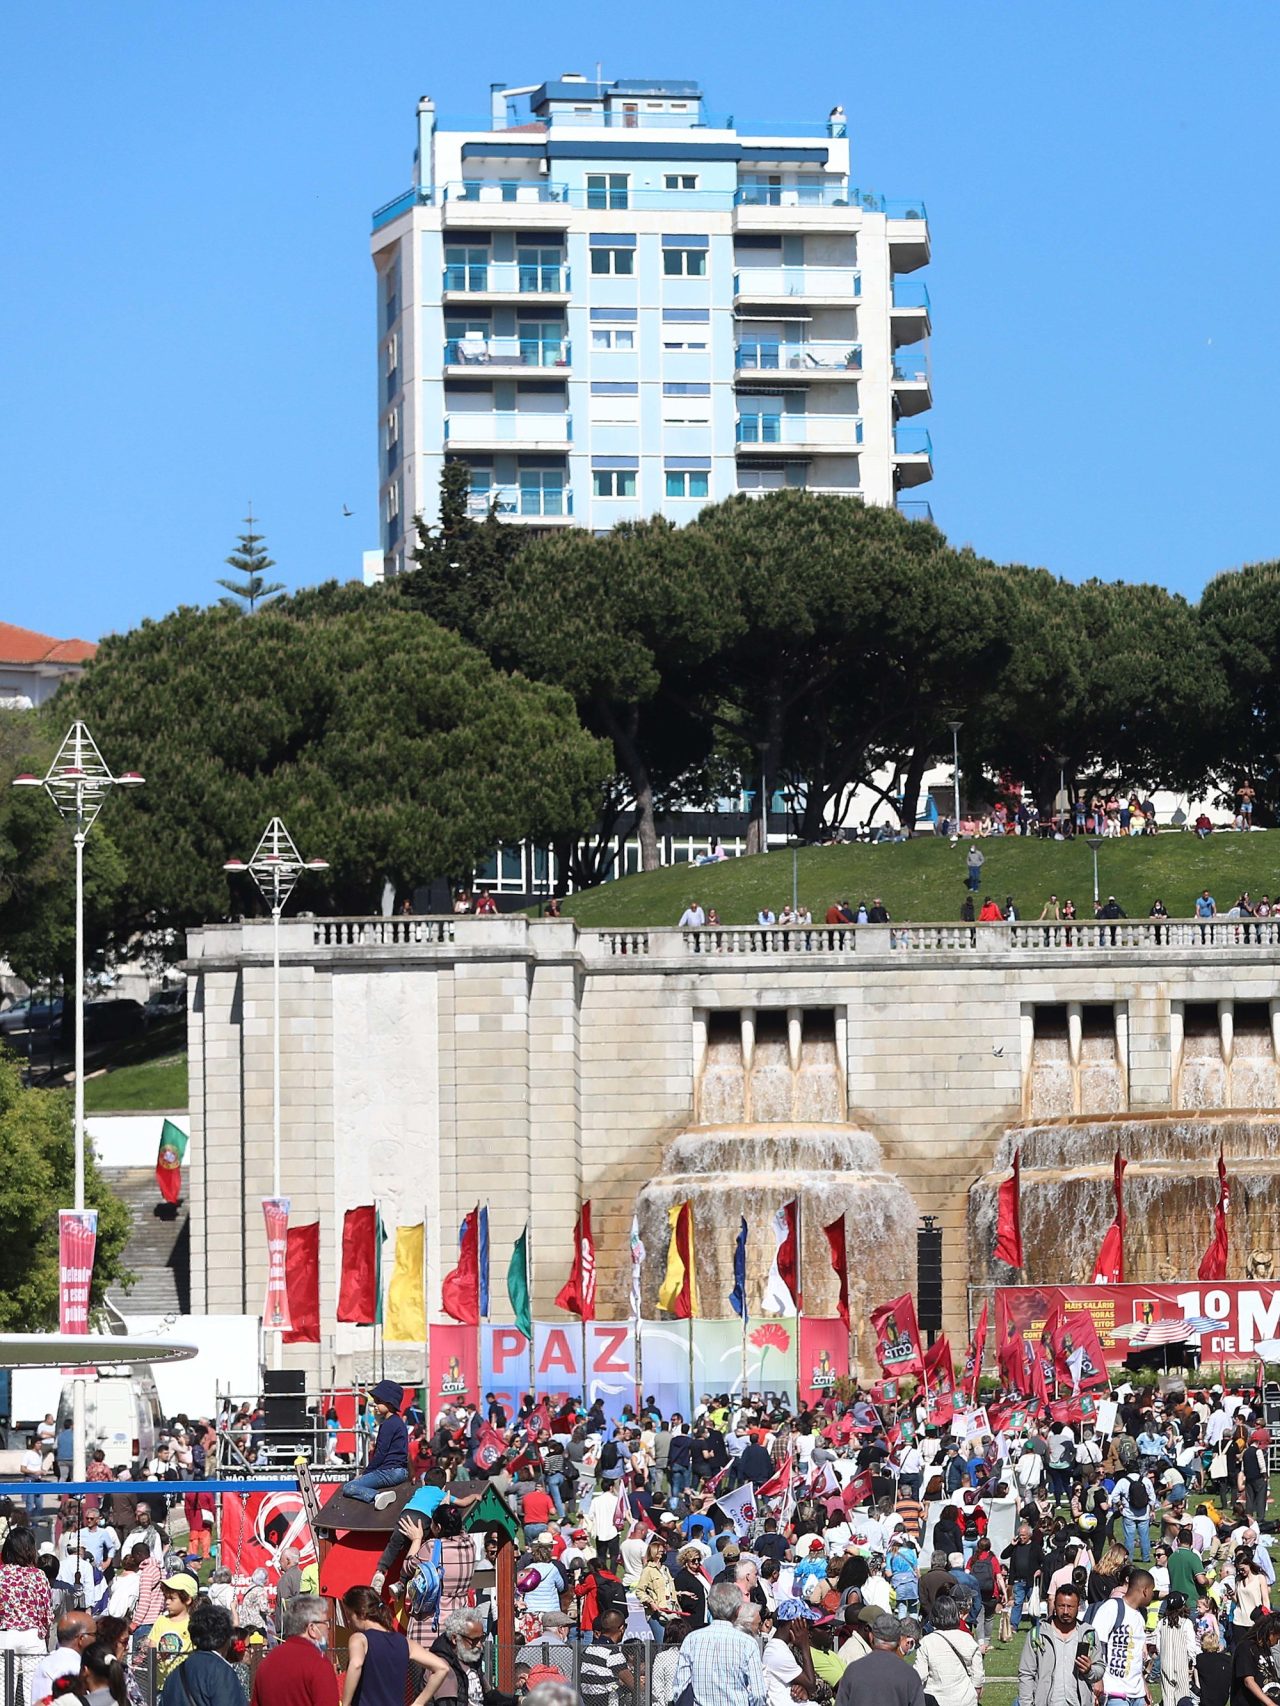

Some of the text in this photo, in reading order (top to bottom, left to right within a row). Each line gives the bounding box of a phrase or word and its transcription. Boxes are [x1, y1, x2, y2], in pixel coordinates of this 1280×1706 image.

[492, 1327, 630, 1374] PAZ
[1212, 1337, 1236, 1352] DE
[813, 1376, 836, 1384] CGTP
[443, 1382, 465, 1391] CGTP
